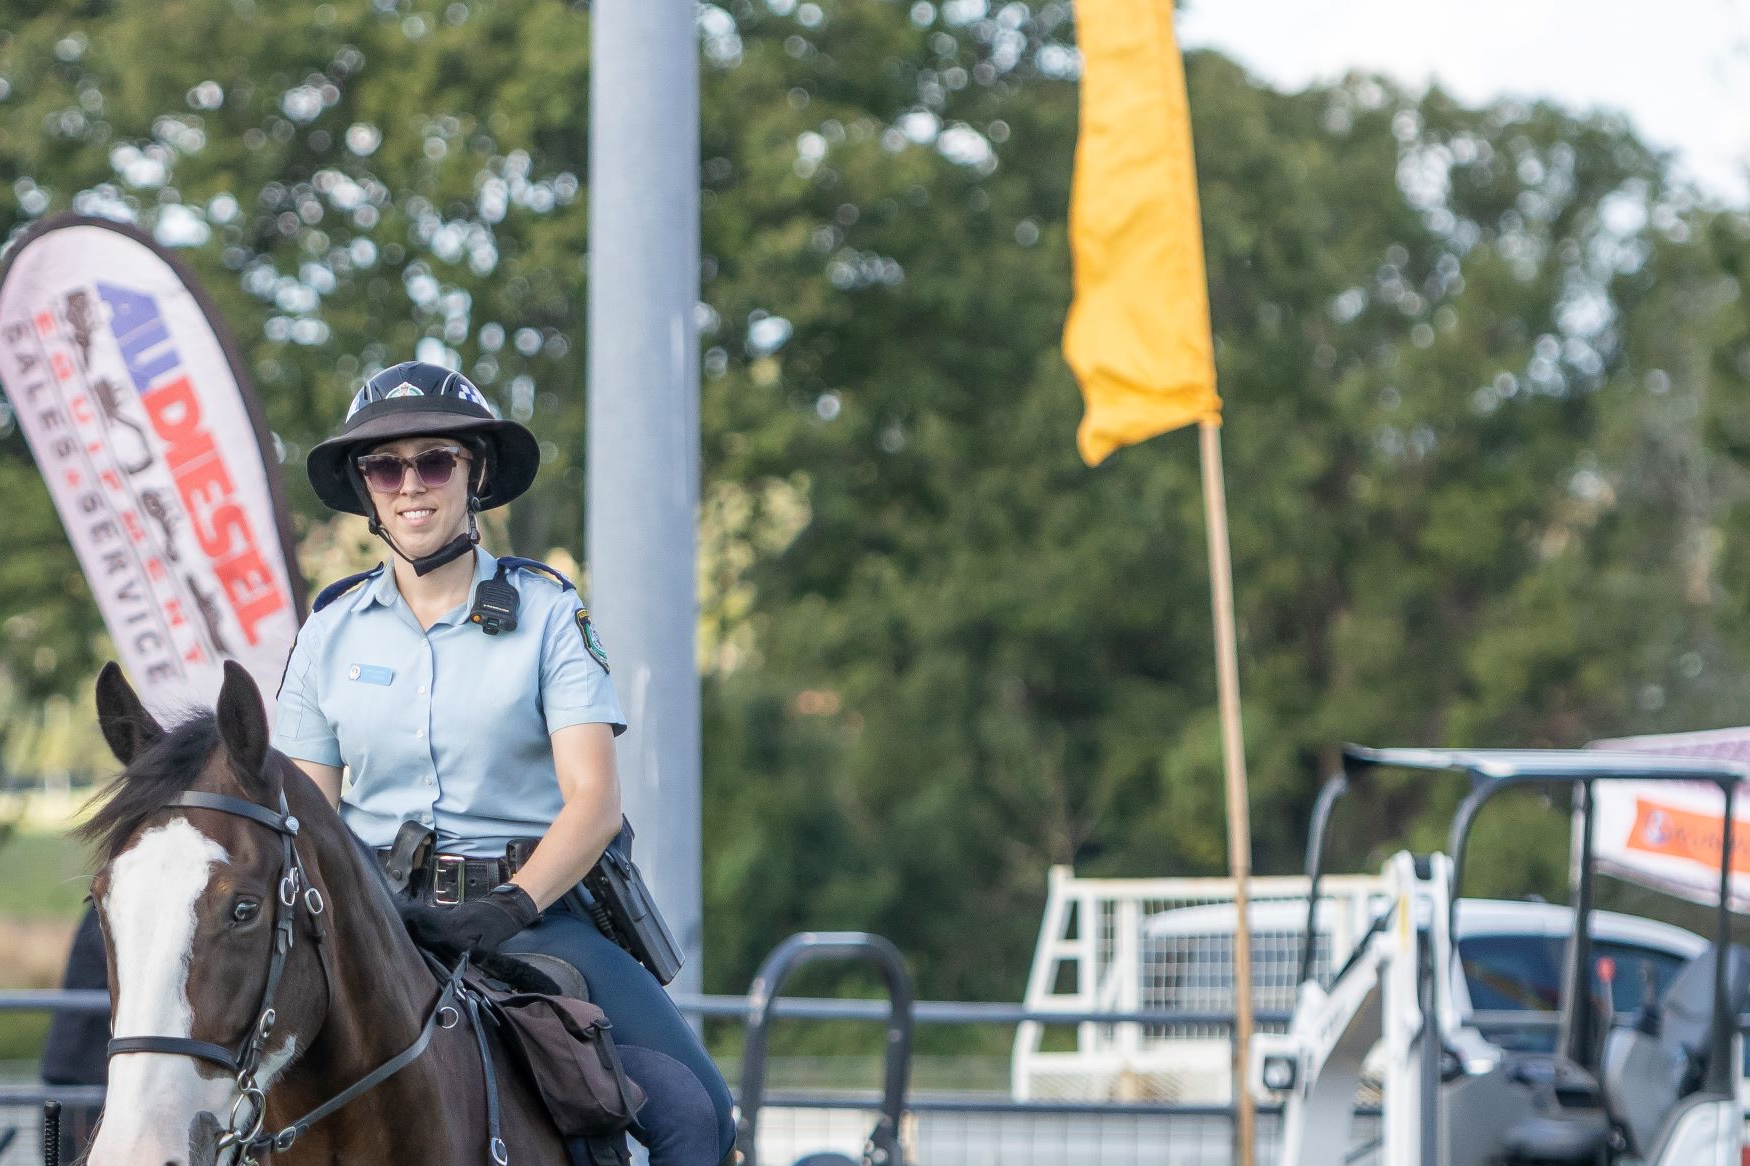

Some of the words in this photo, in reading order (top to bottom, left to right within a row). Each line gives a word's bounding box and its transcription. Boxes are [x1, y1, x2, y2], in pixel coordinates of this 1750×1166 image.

[5, 320, 78, 459] SALES
[79, 493, 180, 684] SERVICE
[33, 311, 207, 665] EQUIPMENT
